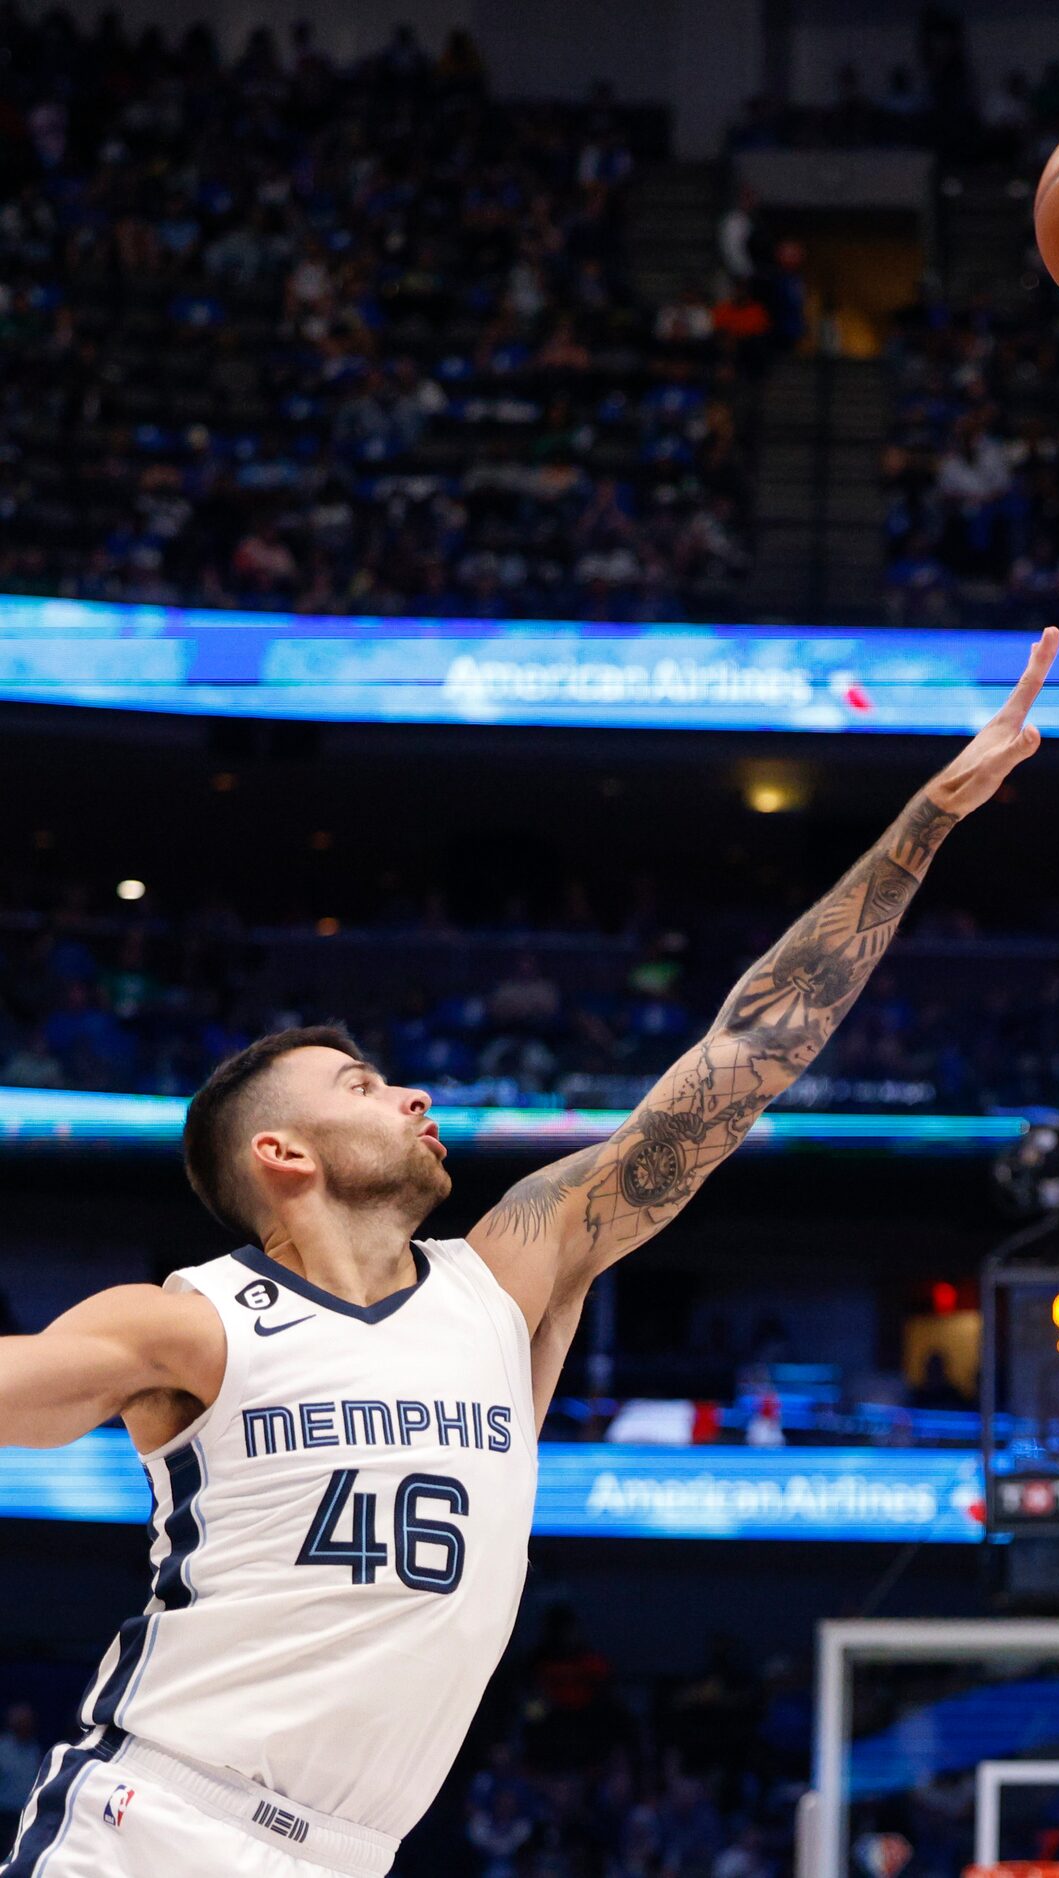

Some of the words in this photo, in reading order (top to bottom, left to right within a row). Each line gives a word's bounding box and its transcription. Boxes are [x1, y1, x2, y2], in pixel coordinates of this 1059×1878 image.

[442, 655, 648, 703] American
[651, 657, 813, 707] Airlines
[243, 1284, 271, 1309] 6
[242, 1400, 512, 1458] MEMPHIS
[587, 1472, 782, 1519] American
[784, 1475, 938, 1524] Airlines
[294, 1469, 470, 1595] 46
